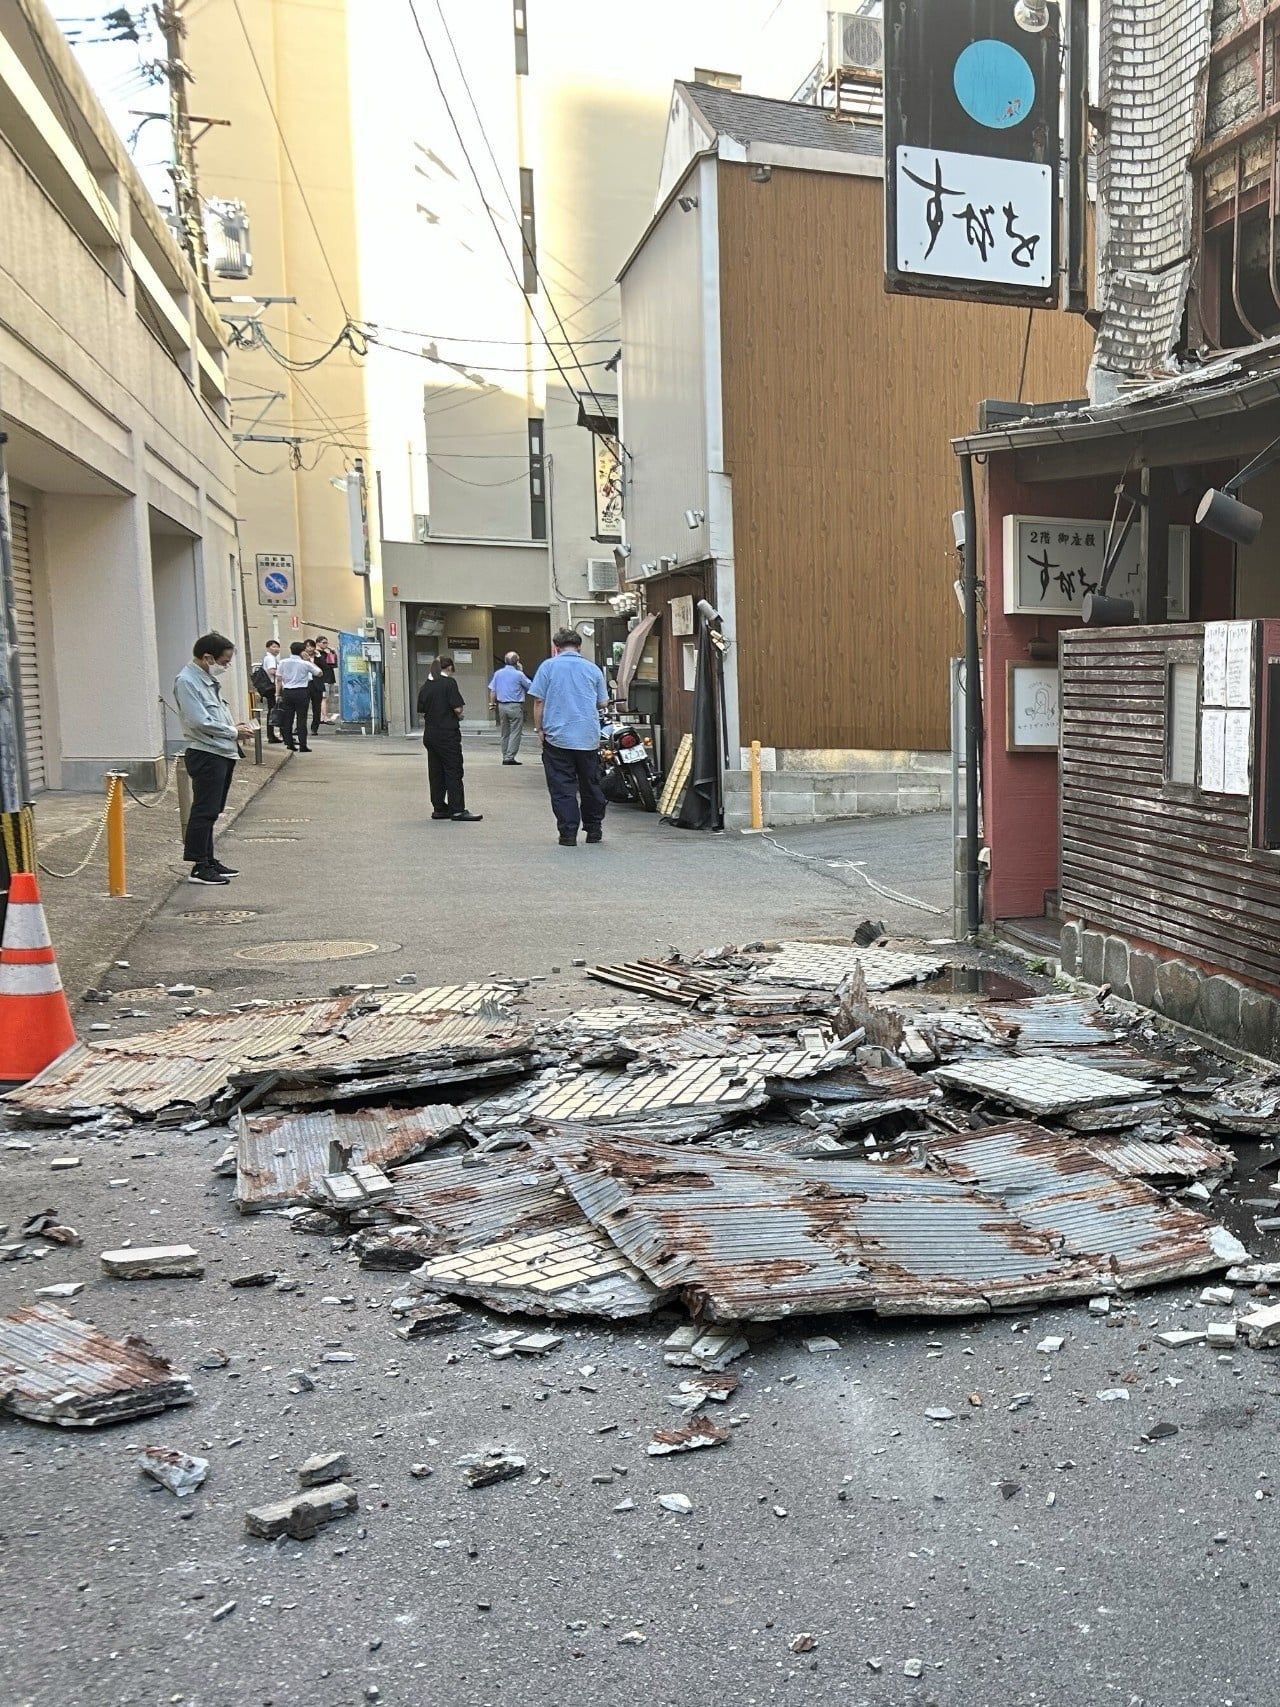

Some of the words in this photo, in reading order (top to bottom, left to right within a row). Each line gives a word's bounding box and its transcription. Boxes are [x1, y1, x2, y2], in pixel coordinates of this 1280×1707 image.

[1030, 531, 1051, 545] 2階
[1057, 532, 1096, 547] 御座敷
